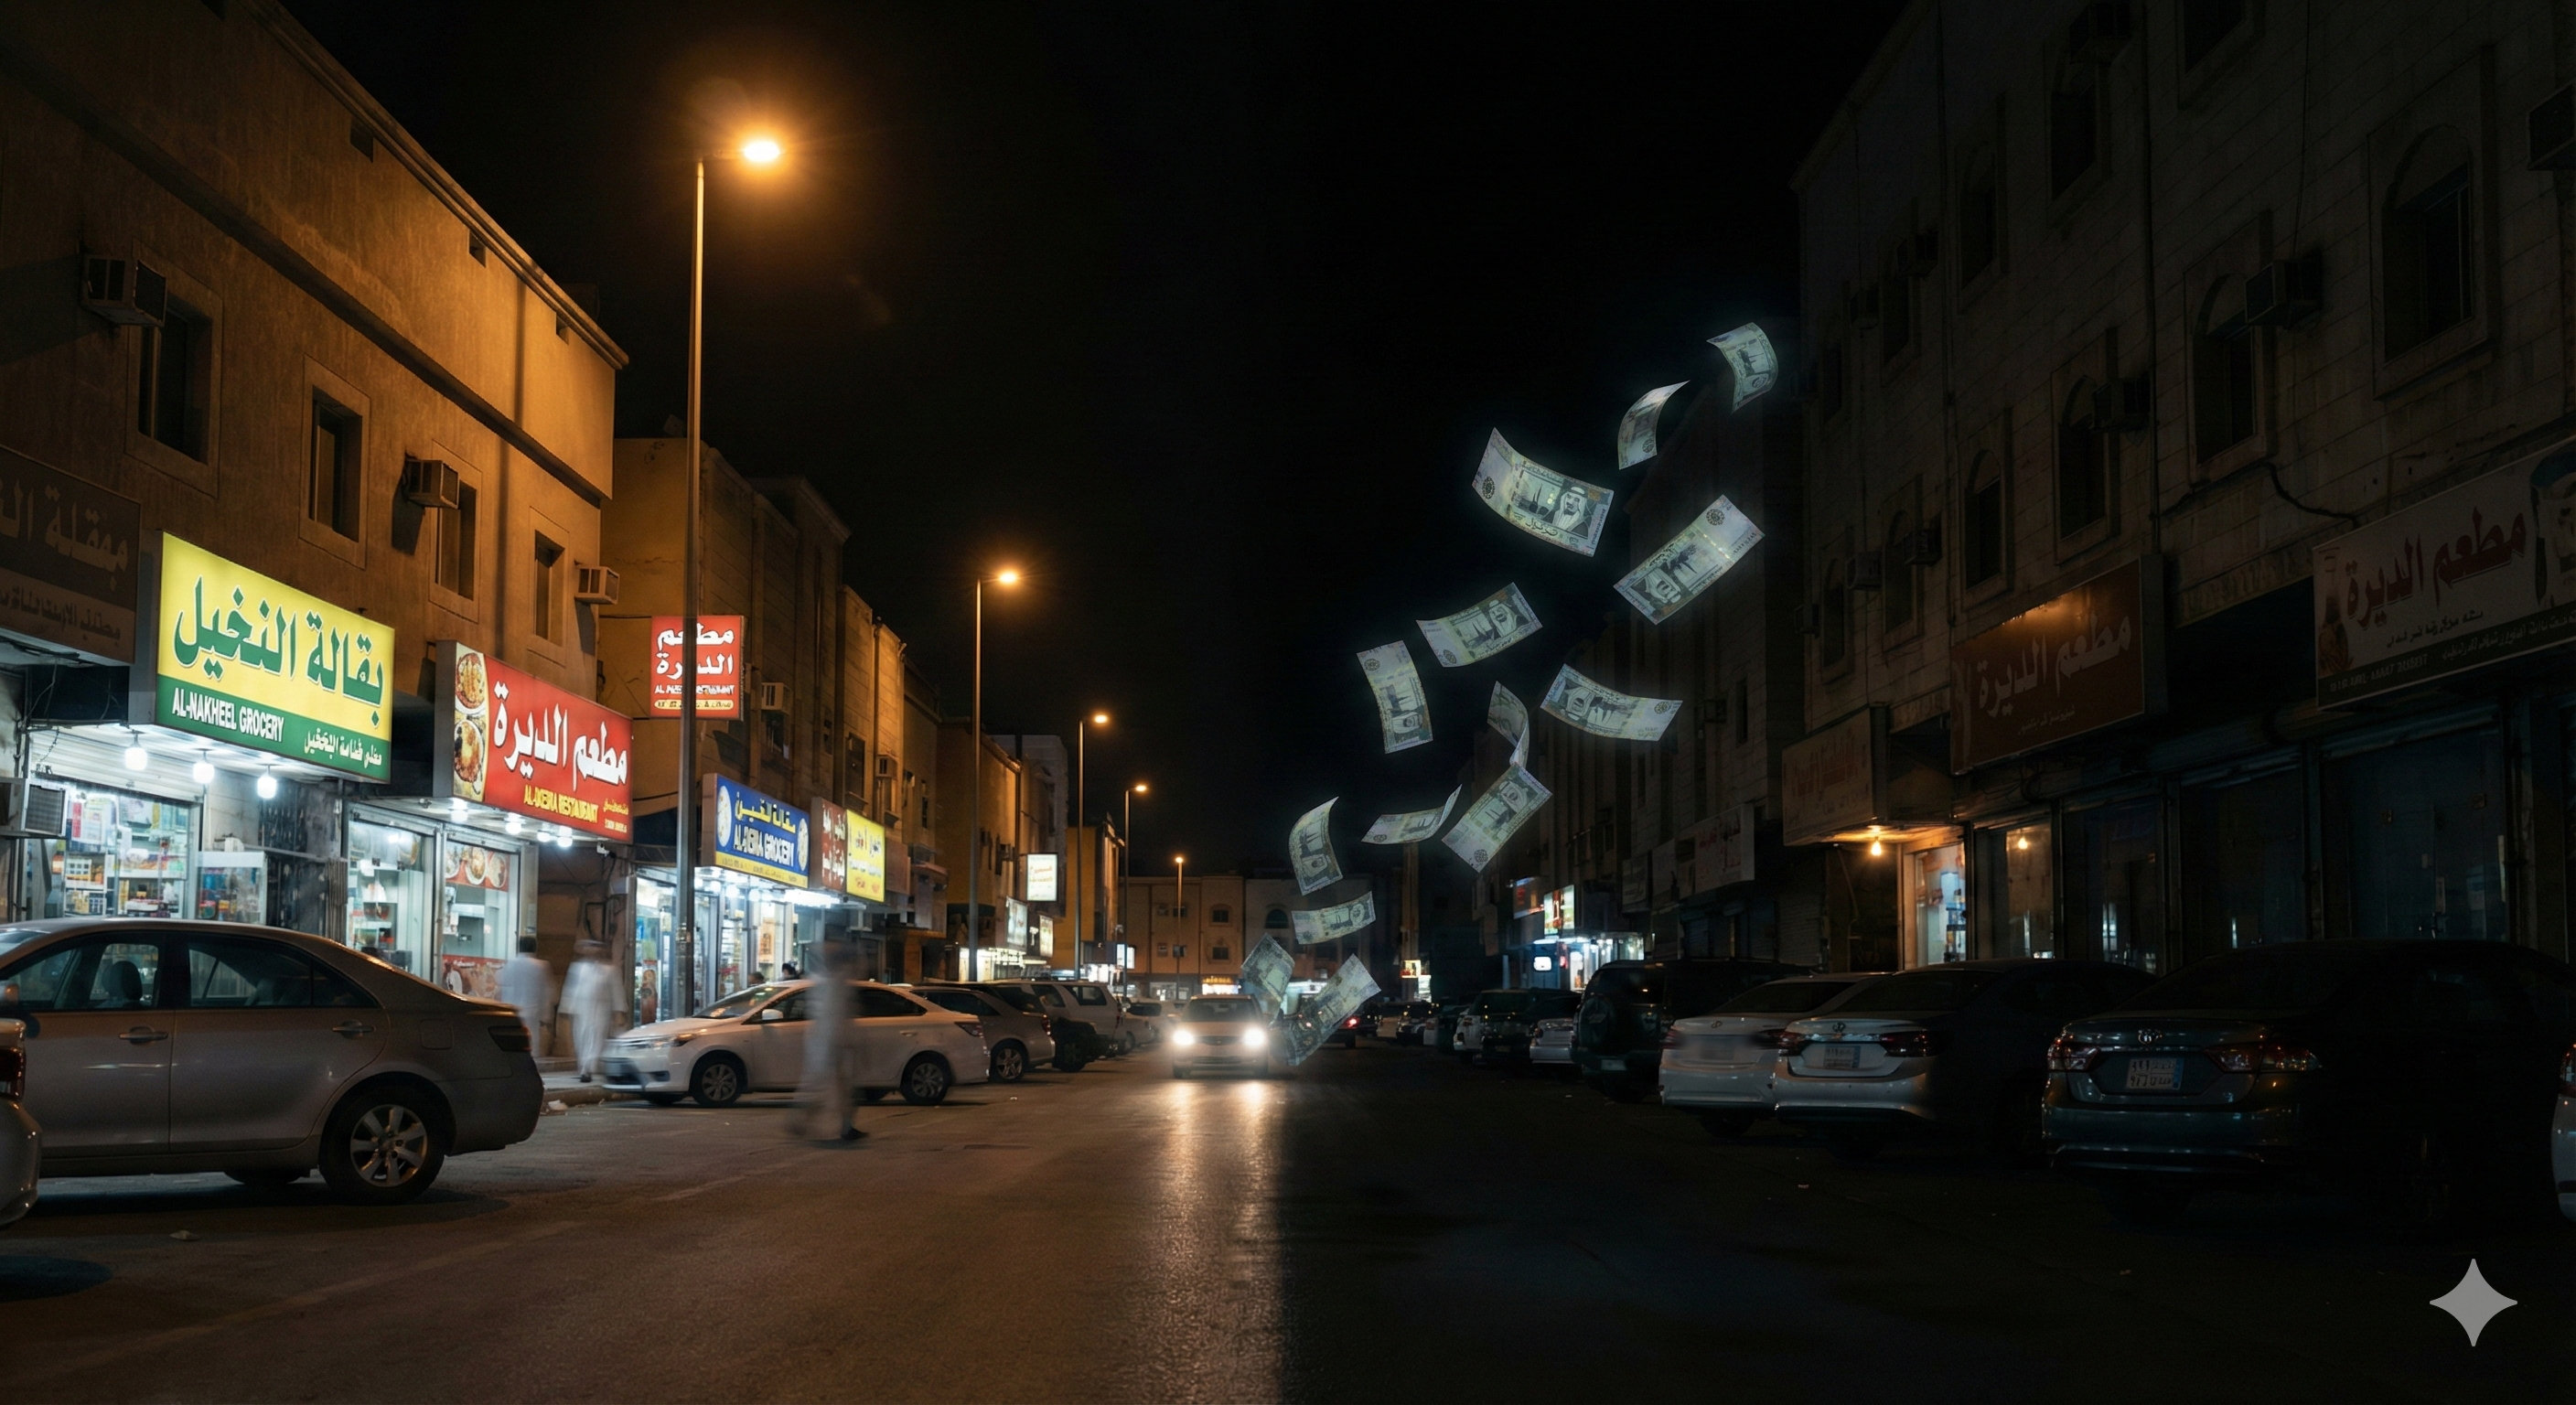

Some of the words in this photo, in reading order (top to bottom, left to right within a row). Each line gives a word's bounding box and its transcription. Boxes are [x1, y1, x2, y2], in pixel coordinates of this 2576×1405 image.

[2345, 533, 2424, 631] الديرة
[2433, 506, 2527, 607] مطعم
[172, 574, 298, 683] النخيل
[306, 609, 384, 729] بقالة
[1976, 634, 2047, 718] الديرة
[2055, 607, 2131, 698] مطعم
[172, 687, 237, 730] AL-NAKHEEL
[239, 705, 284, 743] GROCERY
[493, 681, 568, 779] الديرة
[573, 721, 628, 792] مطعم
